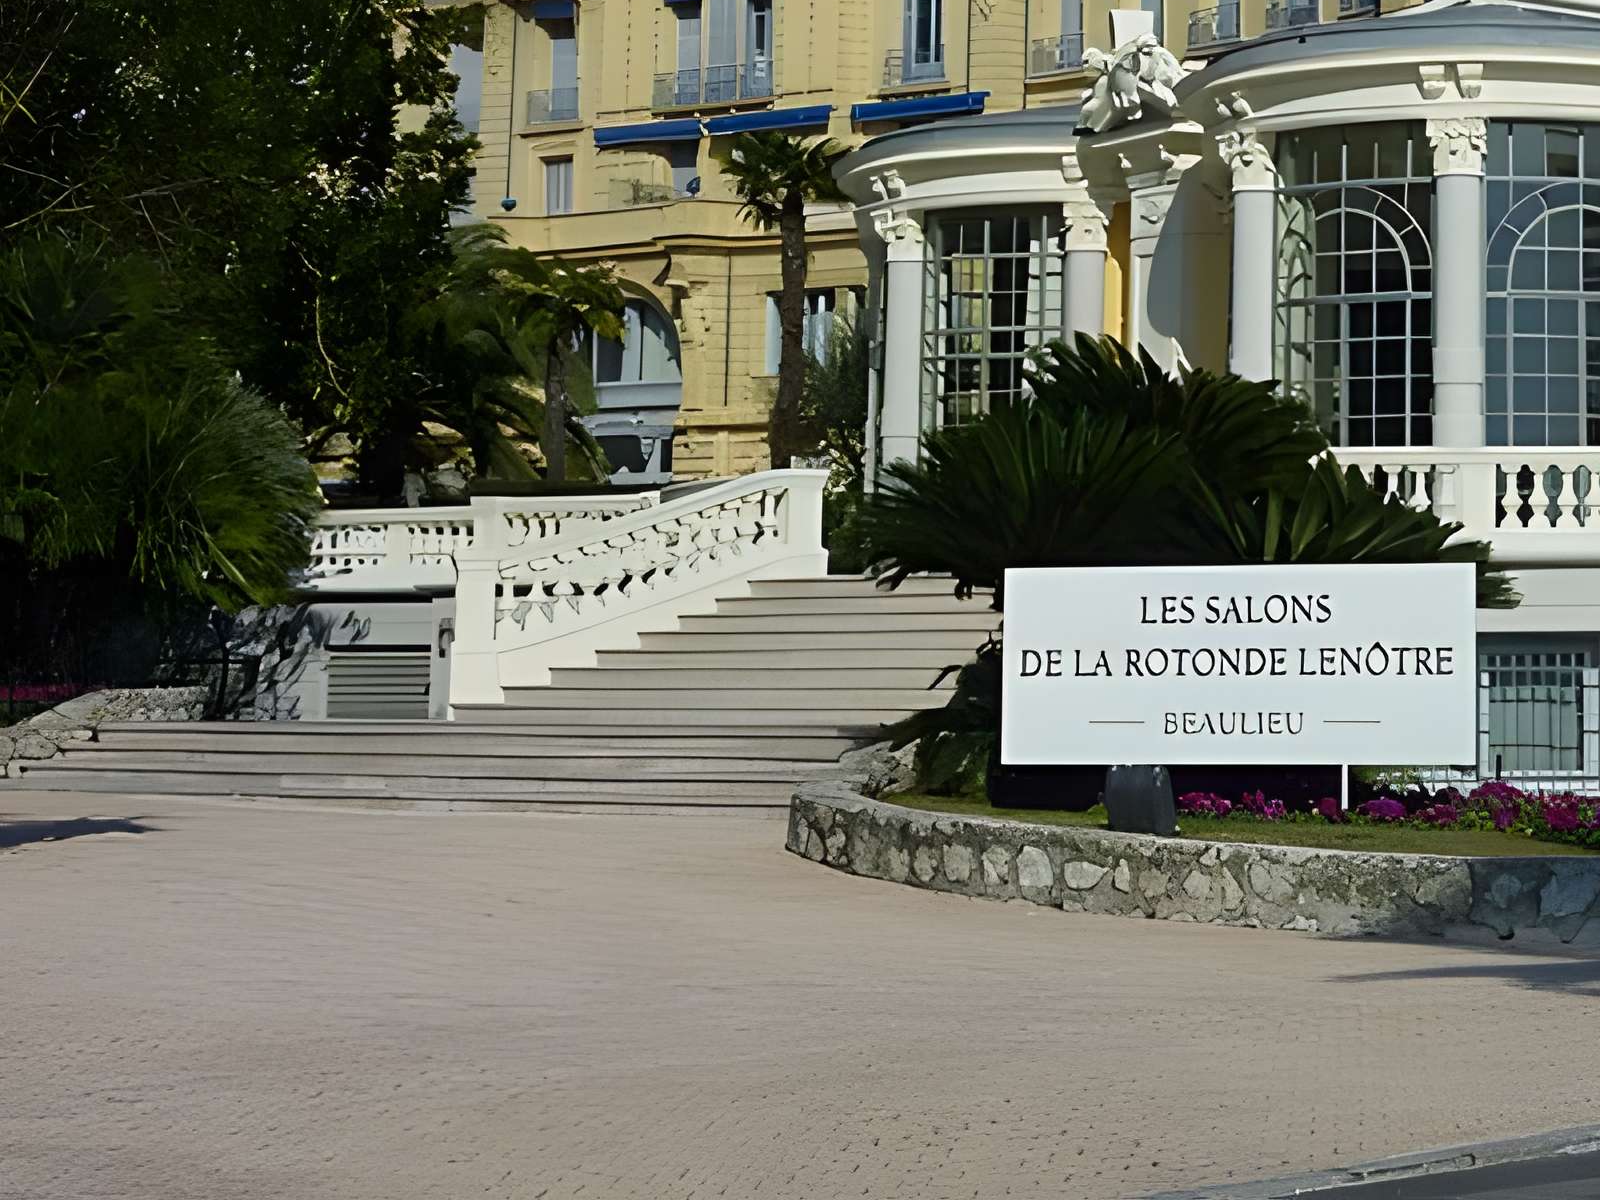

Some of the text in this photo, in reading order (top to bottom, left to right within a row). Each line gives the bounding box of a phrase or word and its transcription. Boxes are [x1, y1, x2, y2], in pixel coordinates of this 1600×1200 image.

[1140, 594, 1332, 625] LES SALONS
[1019, 641, 1454, 677] DE LA ROTONDE LENÔTRE
[1164, 711, 1304, 735] BEAULIEU
